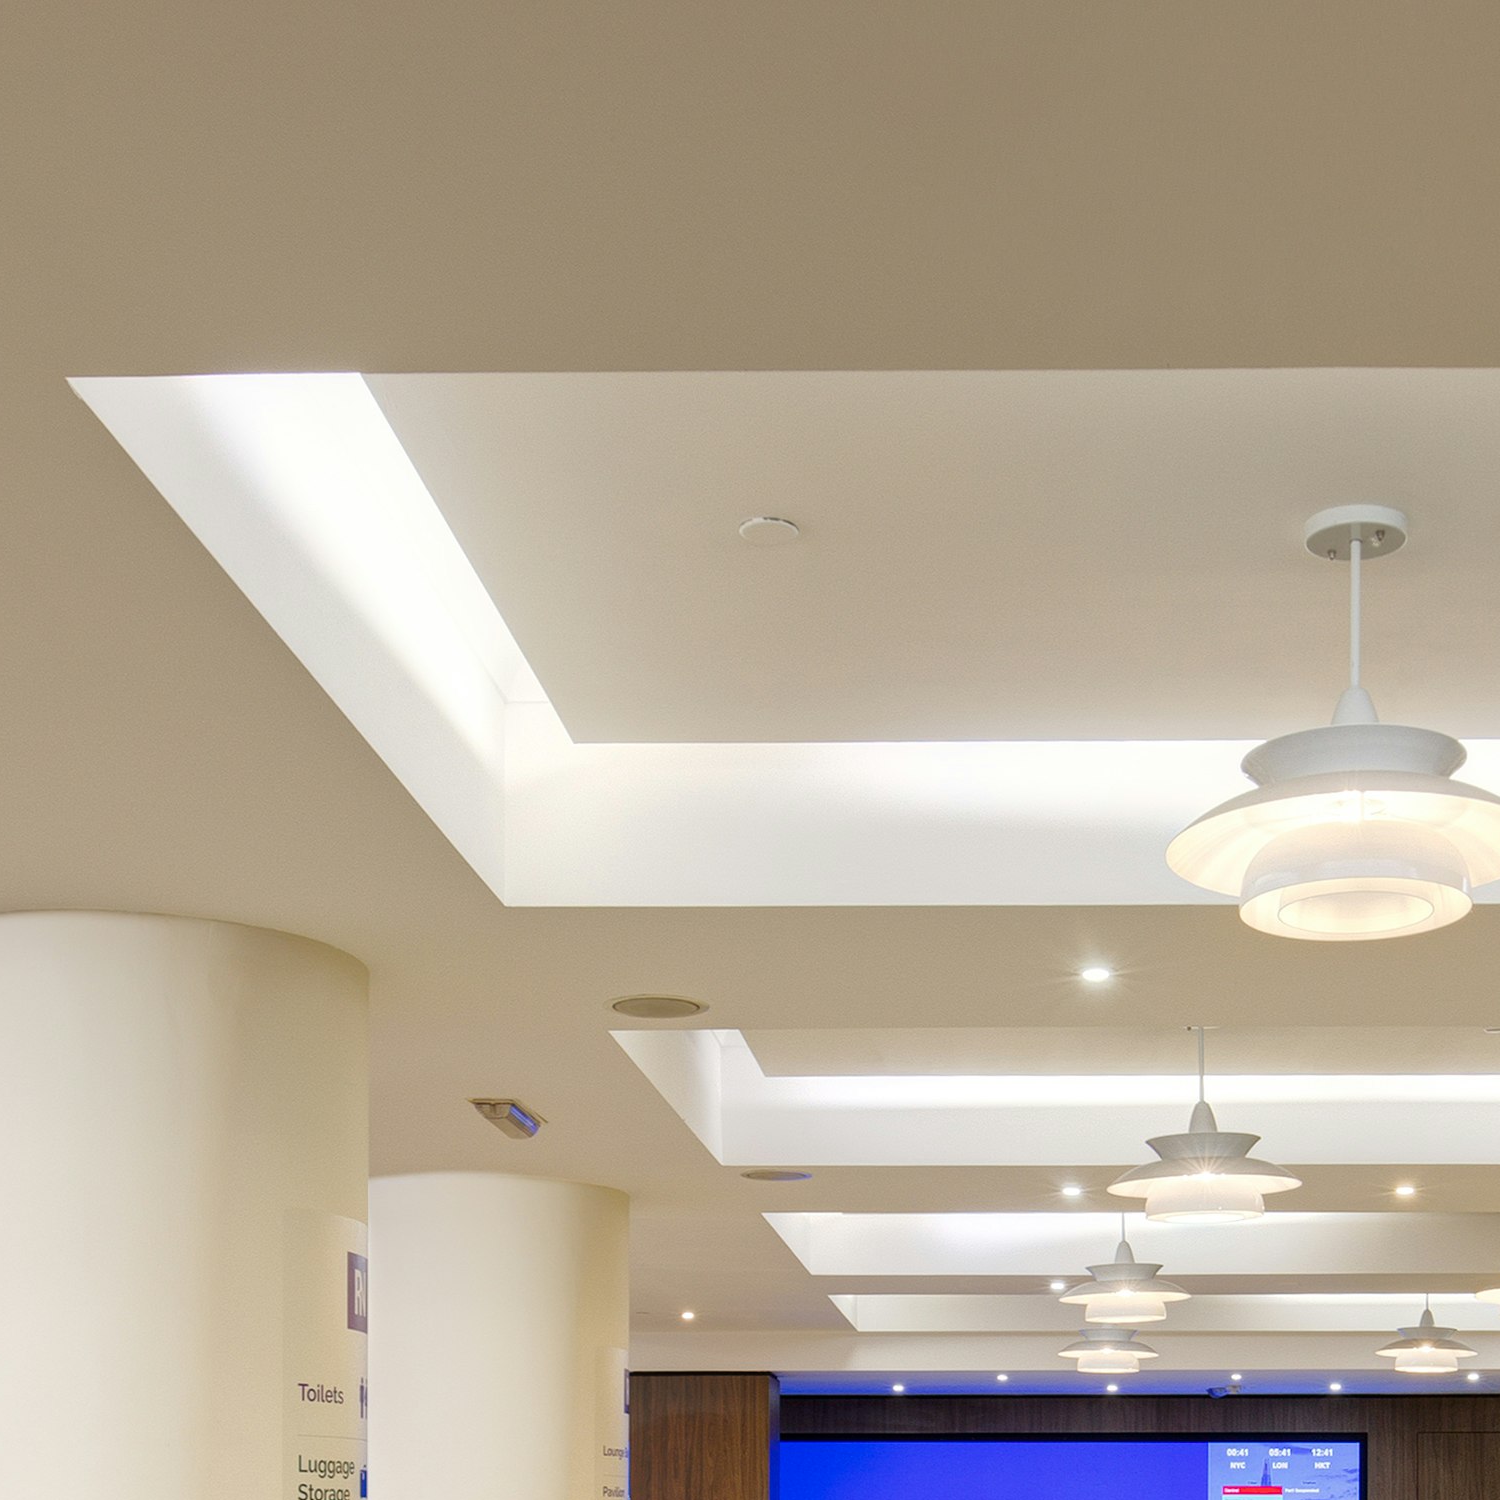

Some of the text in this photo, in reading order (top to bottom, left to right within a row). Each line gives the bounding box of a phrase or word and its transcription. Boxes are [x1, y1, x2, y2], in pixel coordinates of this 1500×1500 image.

[298, 1383, 345, 1404] Toilets
[1311, 1448, 1333, 1457] 12:41
[298, 1454, 355, 1479] Luggage
